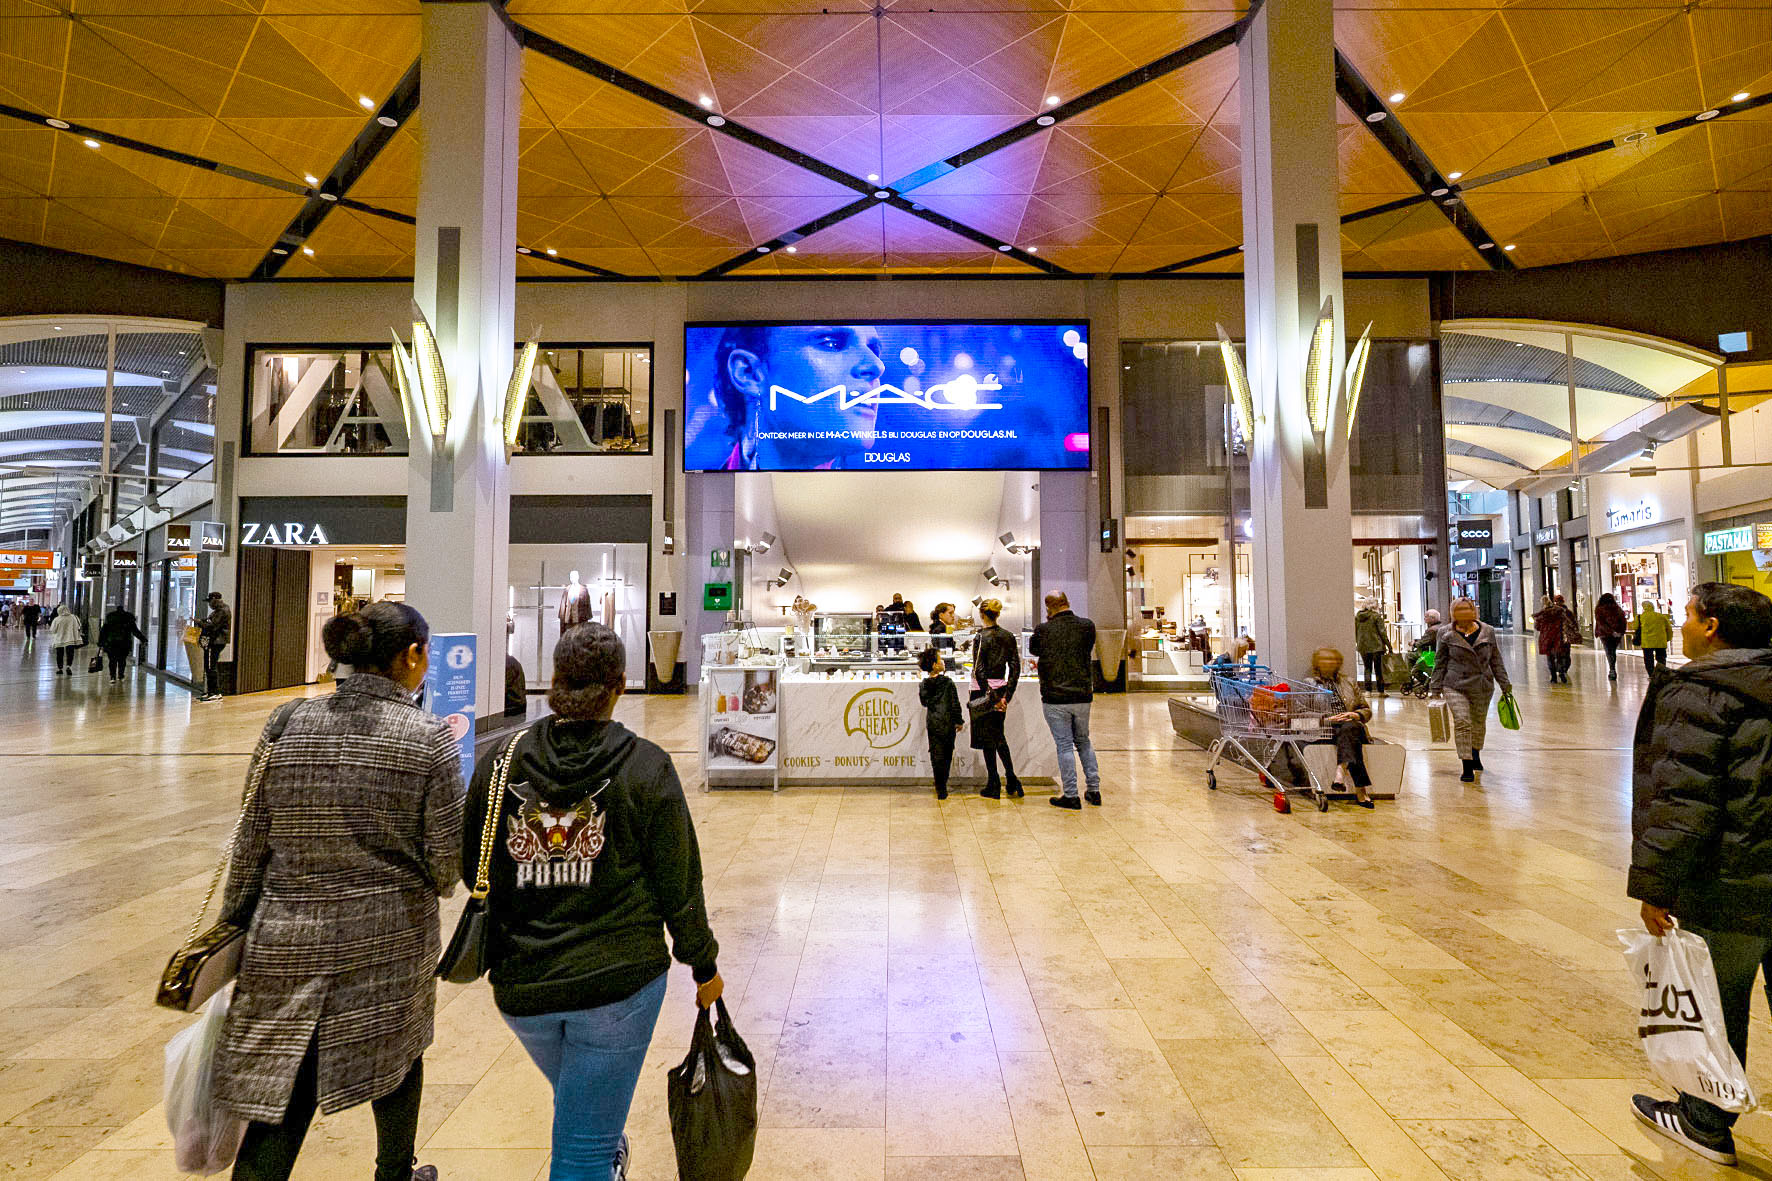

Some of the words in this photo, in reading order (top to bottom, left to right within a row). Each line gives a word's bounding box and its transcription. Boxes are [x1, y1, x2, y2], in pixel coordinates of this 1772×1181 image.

[759, 430, 787, 439] ONTDEK
[788, 430, 806, 439] MEER
[808, 430, 815, 439] IN
[816, 430, 825, 439] DE
[850, 430, 887, 439] WINKELS
[901, 430, 937, 439] DOUGLAS
[939, 430, 949, 439] EN
[949, 430, 960, 439] OP
[961, 430, 1018, 439] DOUGLAS.NL
[864, 452, 911, 463] DOUGLAS
[241, 523, 329, 545] ZARA
[1460, 530, 1491, 538] ecco
[168, 538, 191, 547] ZAR
[202, 537, 223, 546] ZARA
[783, 756, 821, 768] COOKIES
[834, 756, 871, 767] DONUTS
[883, 756, 916, 767] KOFFIE
[1697, 1075, 1736, 1101] 1919
